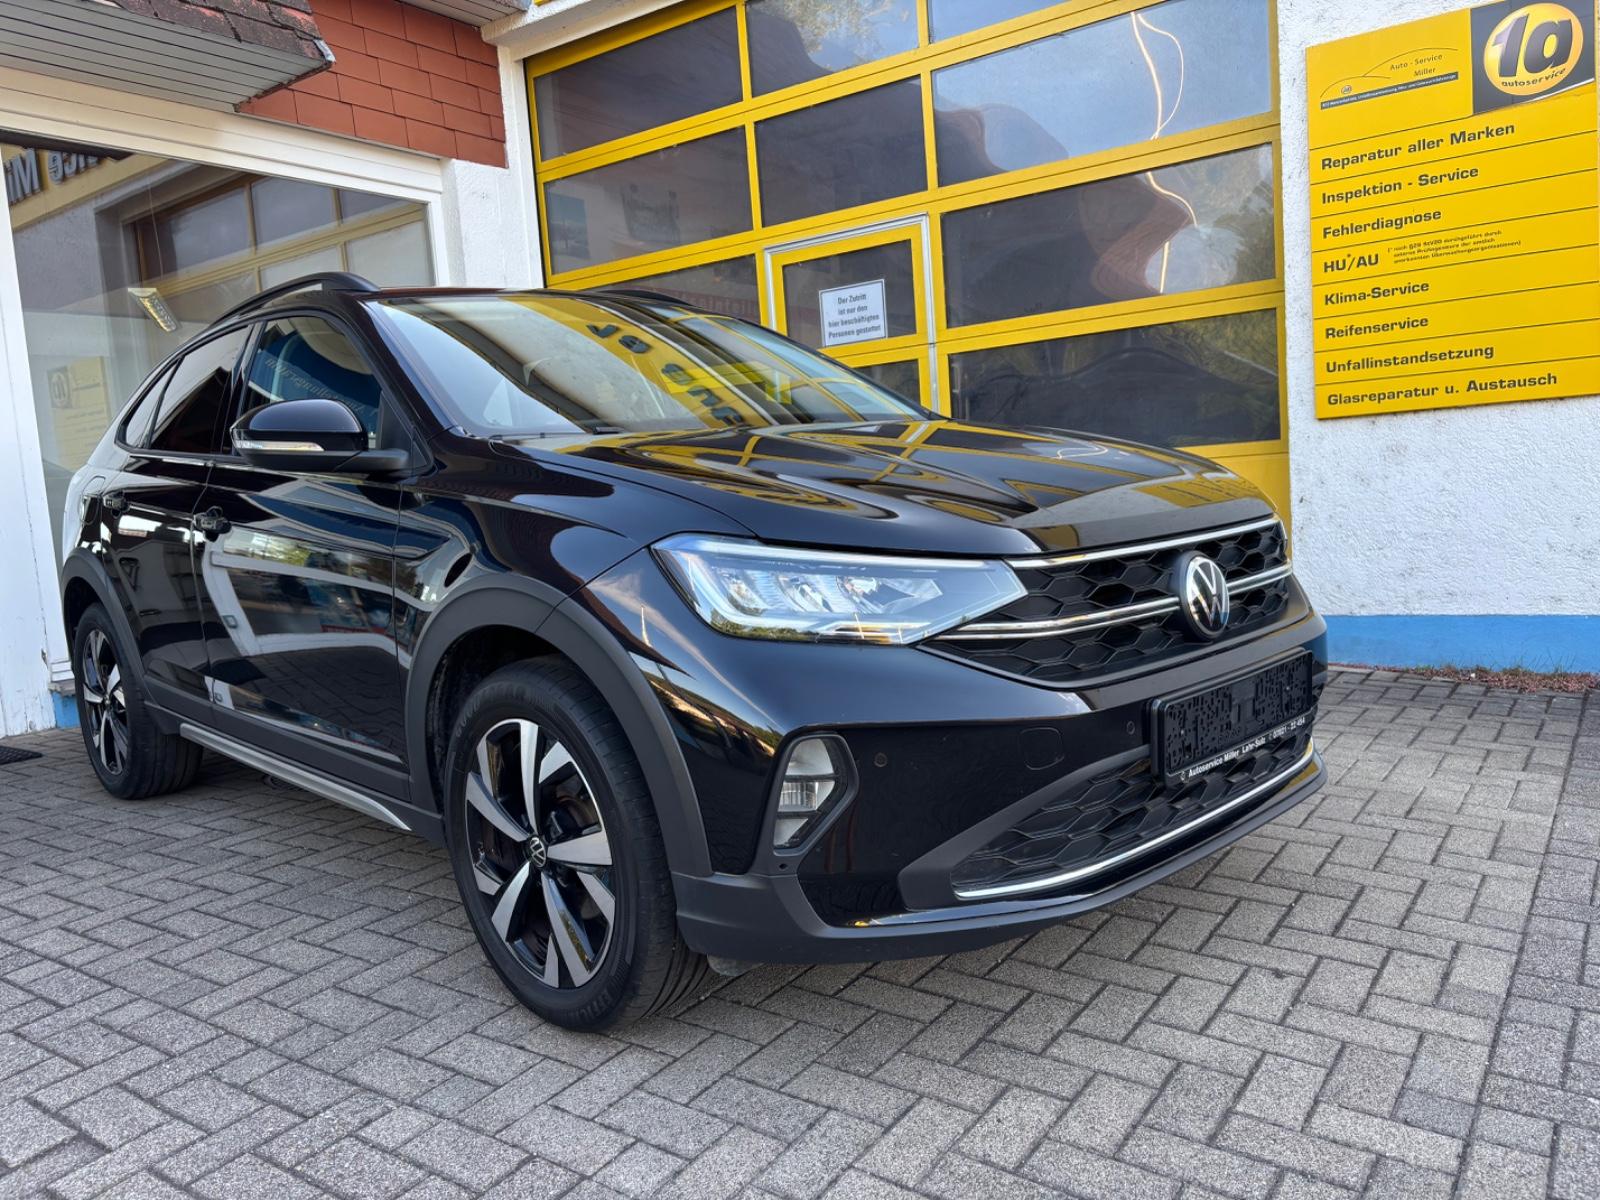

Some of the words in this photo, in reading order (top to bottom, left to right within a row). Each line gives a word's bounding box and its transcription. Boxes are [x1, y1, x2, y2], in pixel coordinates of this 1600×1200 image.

[1390, 61, 1408, 71] Auto
[1414, 54, 1443, 65] Service
[1414, 67, 1436, 77] Miller
[1501, 67, 1566, 88] autoservice
[1321, 145, 1402, 170] Reparatur
[1408, 138, 1443, 154] aller
[1450, 124, 1515, 146] Marken
[1322, 180, 1402, 204] Inspektion
[1418, 167, 1479, 187] Service
[1323, 209, 1442, 239] Fehlerdiagnose
[837, 296, 848, 304] Der
[1324, 282, 1430, 306] Klima-Service
[828, 320, 840, 328] hier
[828, 330, 855, 339] Personen
[1325, 317, 1429, 339] Reifenservice
[1326, 345, 1494, 373] Unfallinstandsetzung
[1327, 385, 1439, 406] Glasreparatur
[1445, 386, 1460, 395] u.
[1466, 373, 1557, 393] Austausch
